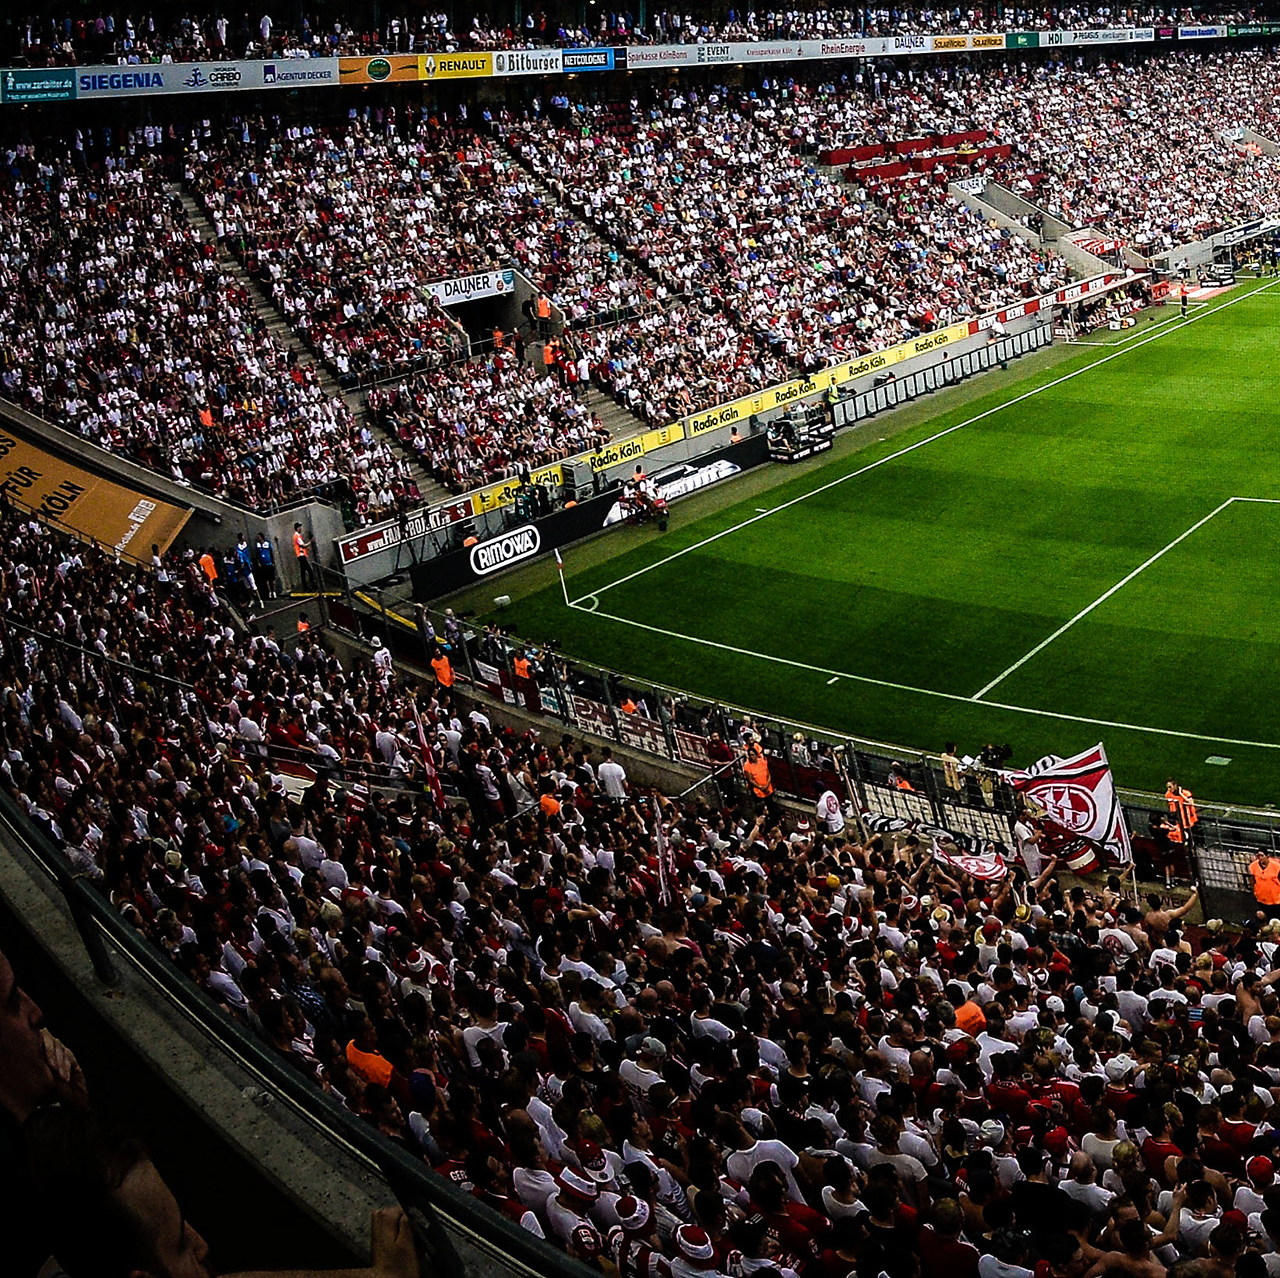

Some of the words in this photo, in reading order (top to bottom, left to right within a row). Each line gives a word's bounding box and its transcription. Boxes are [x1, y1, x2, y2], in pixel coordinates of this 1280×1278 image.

[821, 42, 866, 55] RheinEnergie
[1047, 33, 1063, 44] HDI
[707, 45, 730, 56] EVENT
[440, 59, 487, 72] RENAULT
[508, 53, 561, 73] Bitburger
[80, 73, 164, 91] SIEGENIA
[277, 72, 306, 81] AGENTUR
[308, 70, 332, 79] DECKER
[445, 275, 490, 297] DAUNER
[1006, 306, 1025, 320] REWE
[849, 363, 869, 377] Radio
[870, 355, 886, 368] Köln
[775, 385, 797, 404] Radio
[799, 378, 816, 397] Köln
[693, 412, 718, 433] Radio
[720, 407, 739, 427] Köln
[590, 451, 617, 469] Radio
[619, 442, 642, 460] Köln
[0, 466, 43, 497] FÜR
[37, 479, 86, 520] KÖLN
[478, 531, 534, 569] RIMOWA
